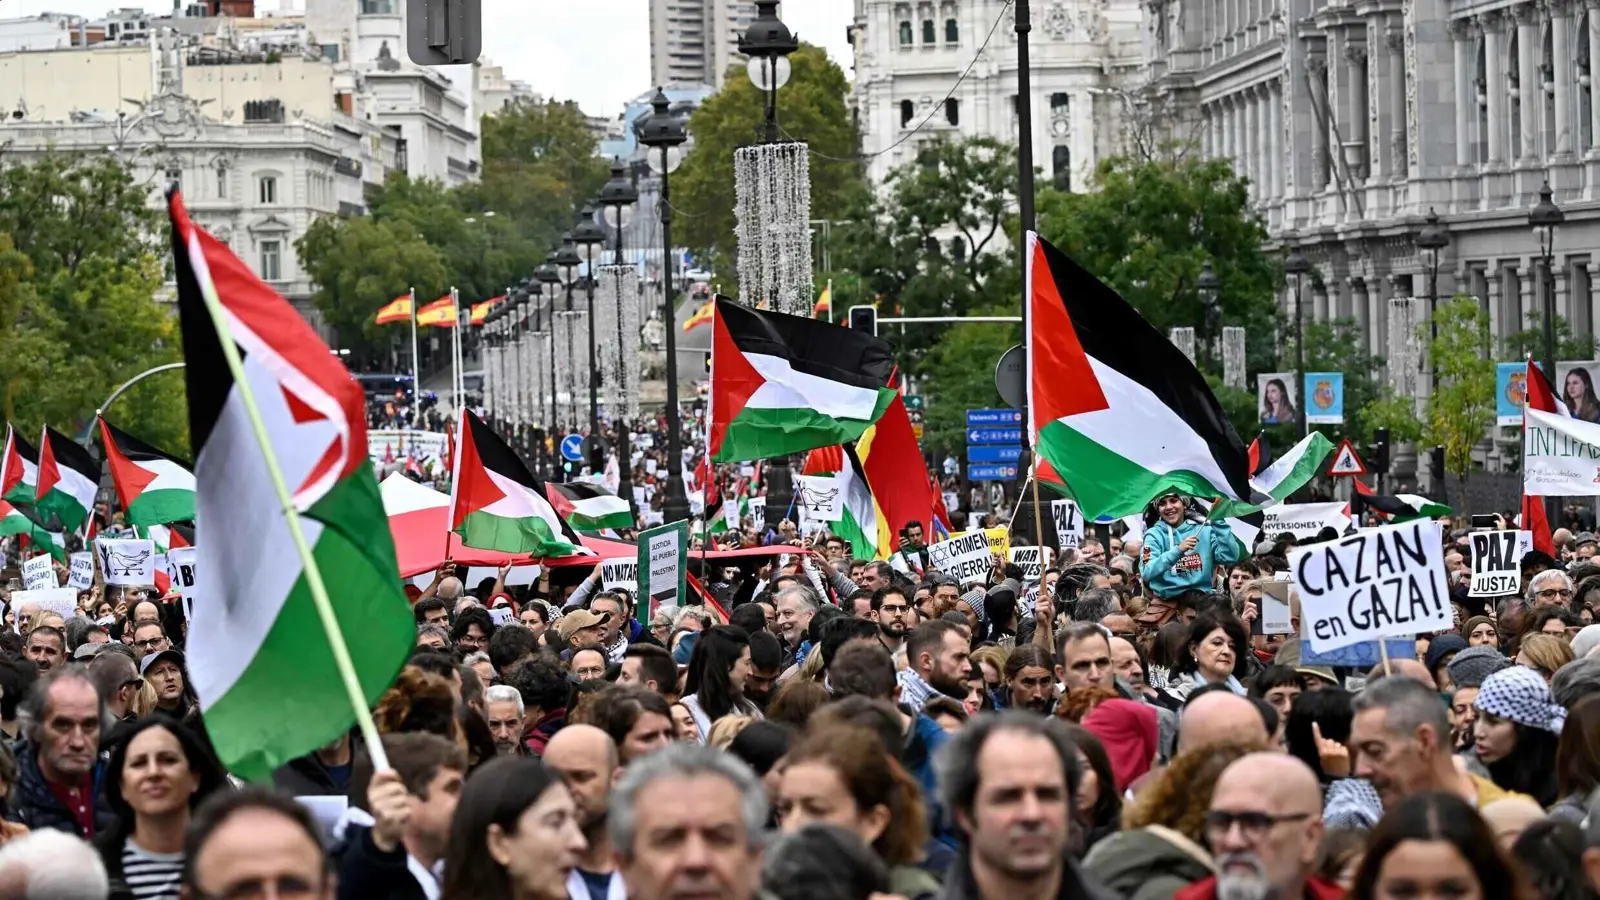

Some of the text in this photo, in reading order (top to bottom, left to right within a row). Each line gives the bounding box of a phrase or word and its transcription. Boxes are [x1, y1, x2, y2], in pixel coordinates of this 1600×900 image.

[754, 505, 765, 520] PA
[1054, 504, 1074, 530] PAZ
[948, 532, 988, 558] CRIMEN
[1473, 532, 1516, 574] PAZ
[658, 549, 677, 561] PUEBLO
[1014, 550, 1038, 562] WAR
[1298, 524, 1427, 596] CAZAN
[73, 559, 92, 571] JUSTA
[602, 564, 614, 582] NO
[652, 564, 676, 576] PALESTINO
[71, 570, 81, 582] PAZ
[1473, 576, 1517, 592] JUSTA
[1314, 569, 1444, 640] en GAZA!
